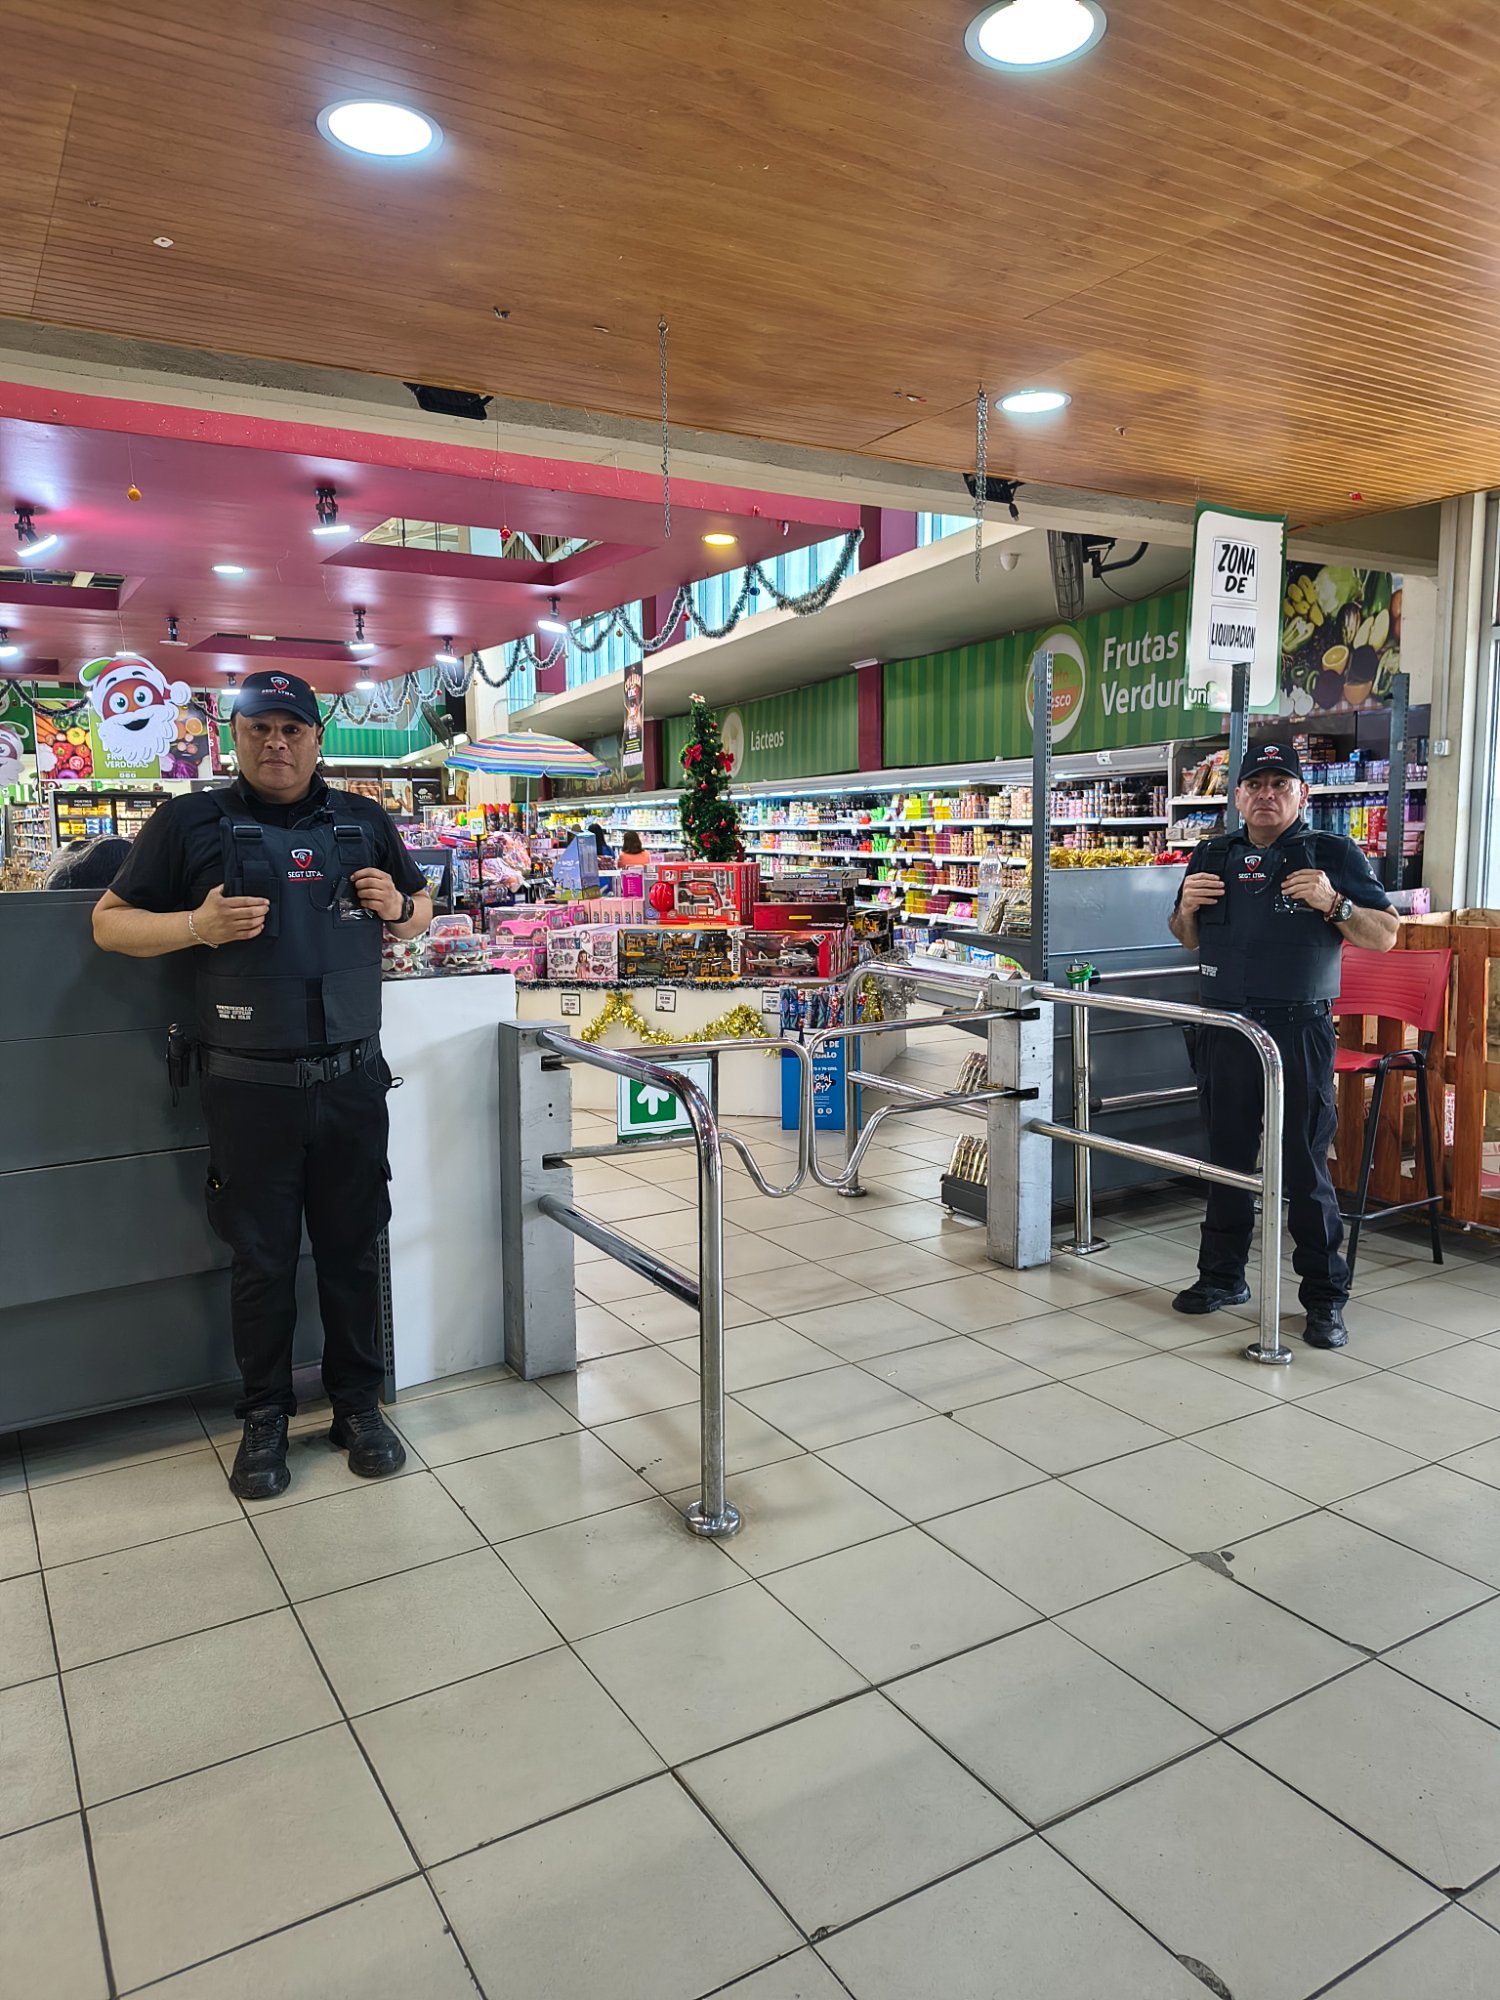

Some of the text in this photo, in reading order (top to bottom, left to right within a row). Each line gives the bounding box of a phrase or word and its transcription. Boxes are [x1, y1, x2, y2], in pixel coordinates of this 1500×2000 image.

[1217, 544, 1256, 577] ZONA
[1224, 575, 1248, 593] DE
[1210, 622, 1256, 650] LIQUIDACION
[1103, 631, 1179, 672] Frutas
[1101, 673, 1184, 716] Verdur
[751, 729, 785, 751] Lácteos
[829, 1040, 839, 1048] DE
